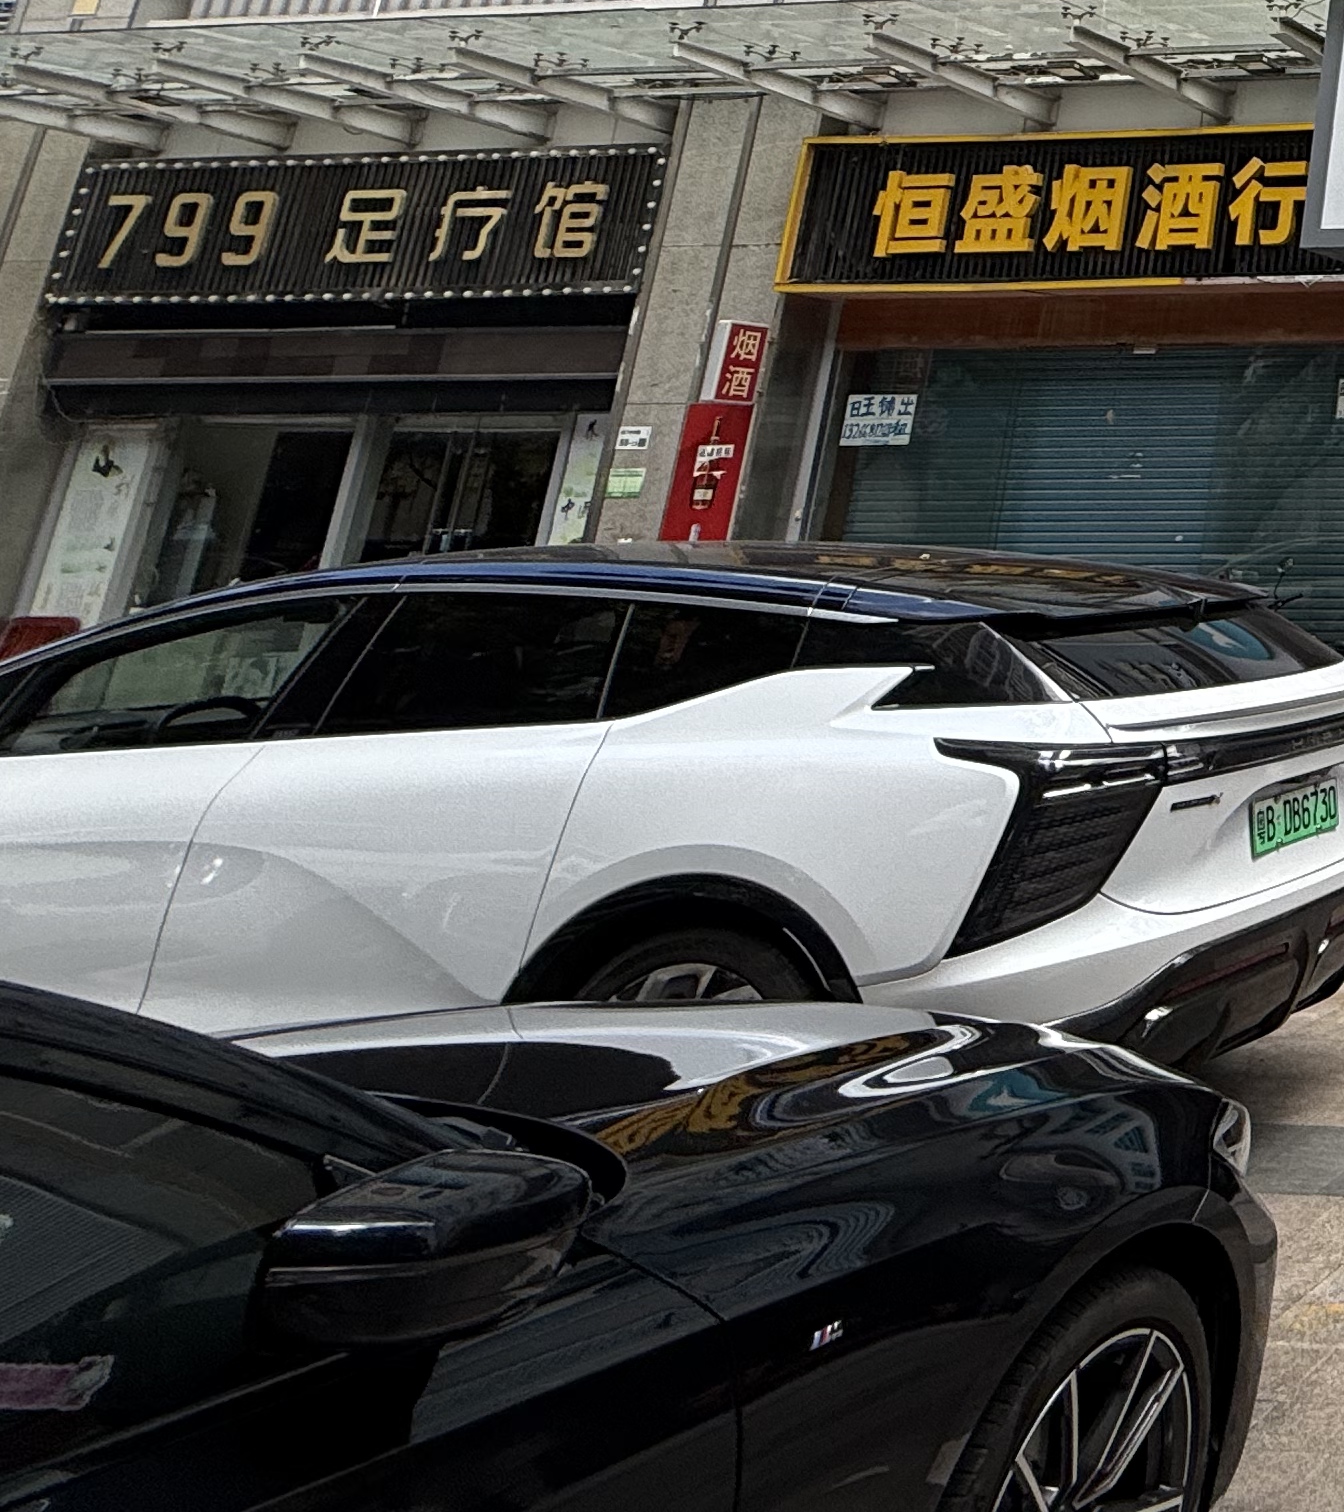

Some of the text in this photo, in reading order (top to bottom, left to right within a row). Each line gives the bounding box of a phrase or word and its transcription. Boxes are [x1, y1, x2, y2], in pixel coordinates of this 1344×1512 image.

[97, 179, 610, 268] 799 足疗馆
[872, 157, 1308, 258] 恒盛烟酒行
[721, 328, 762, 399] 烟酒
